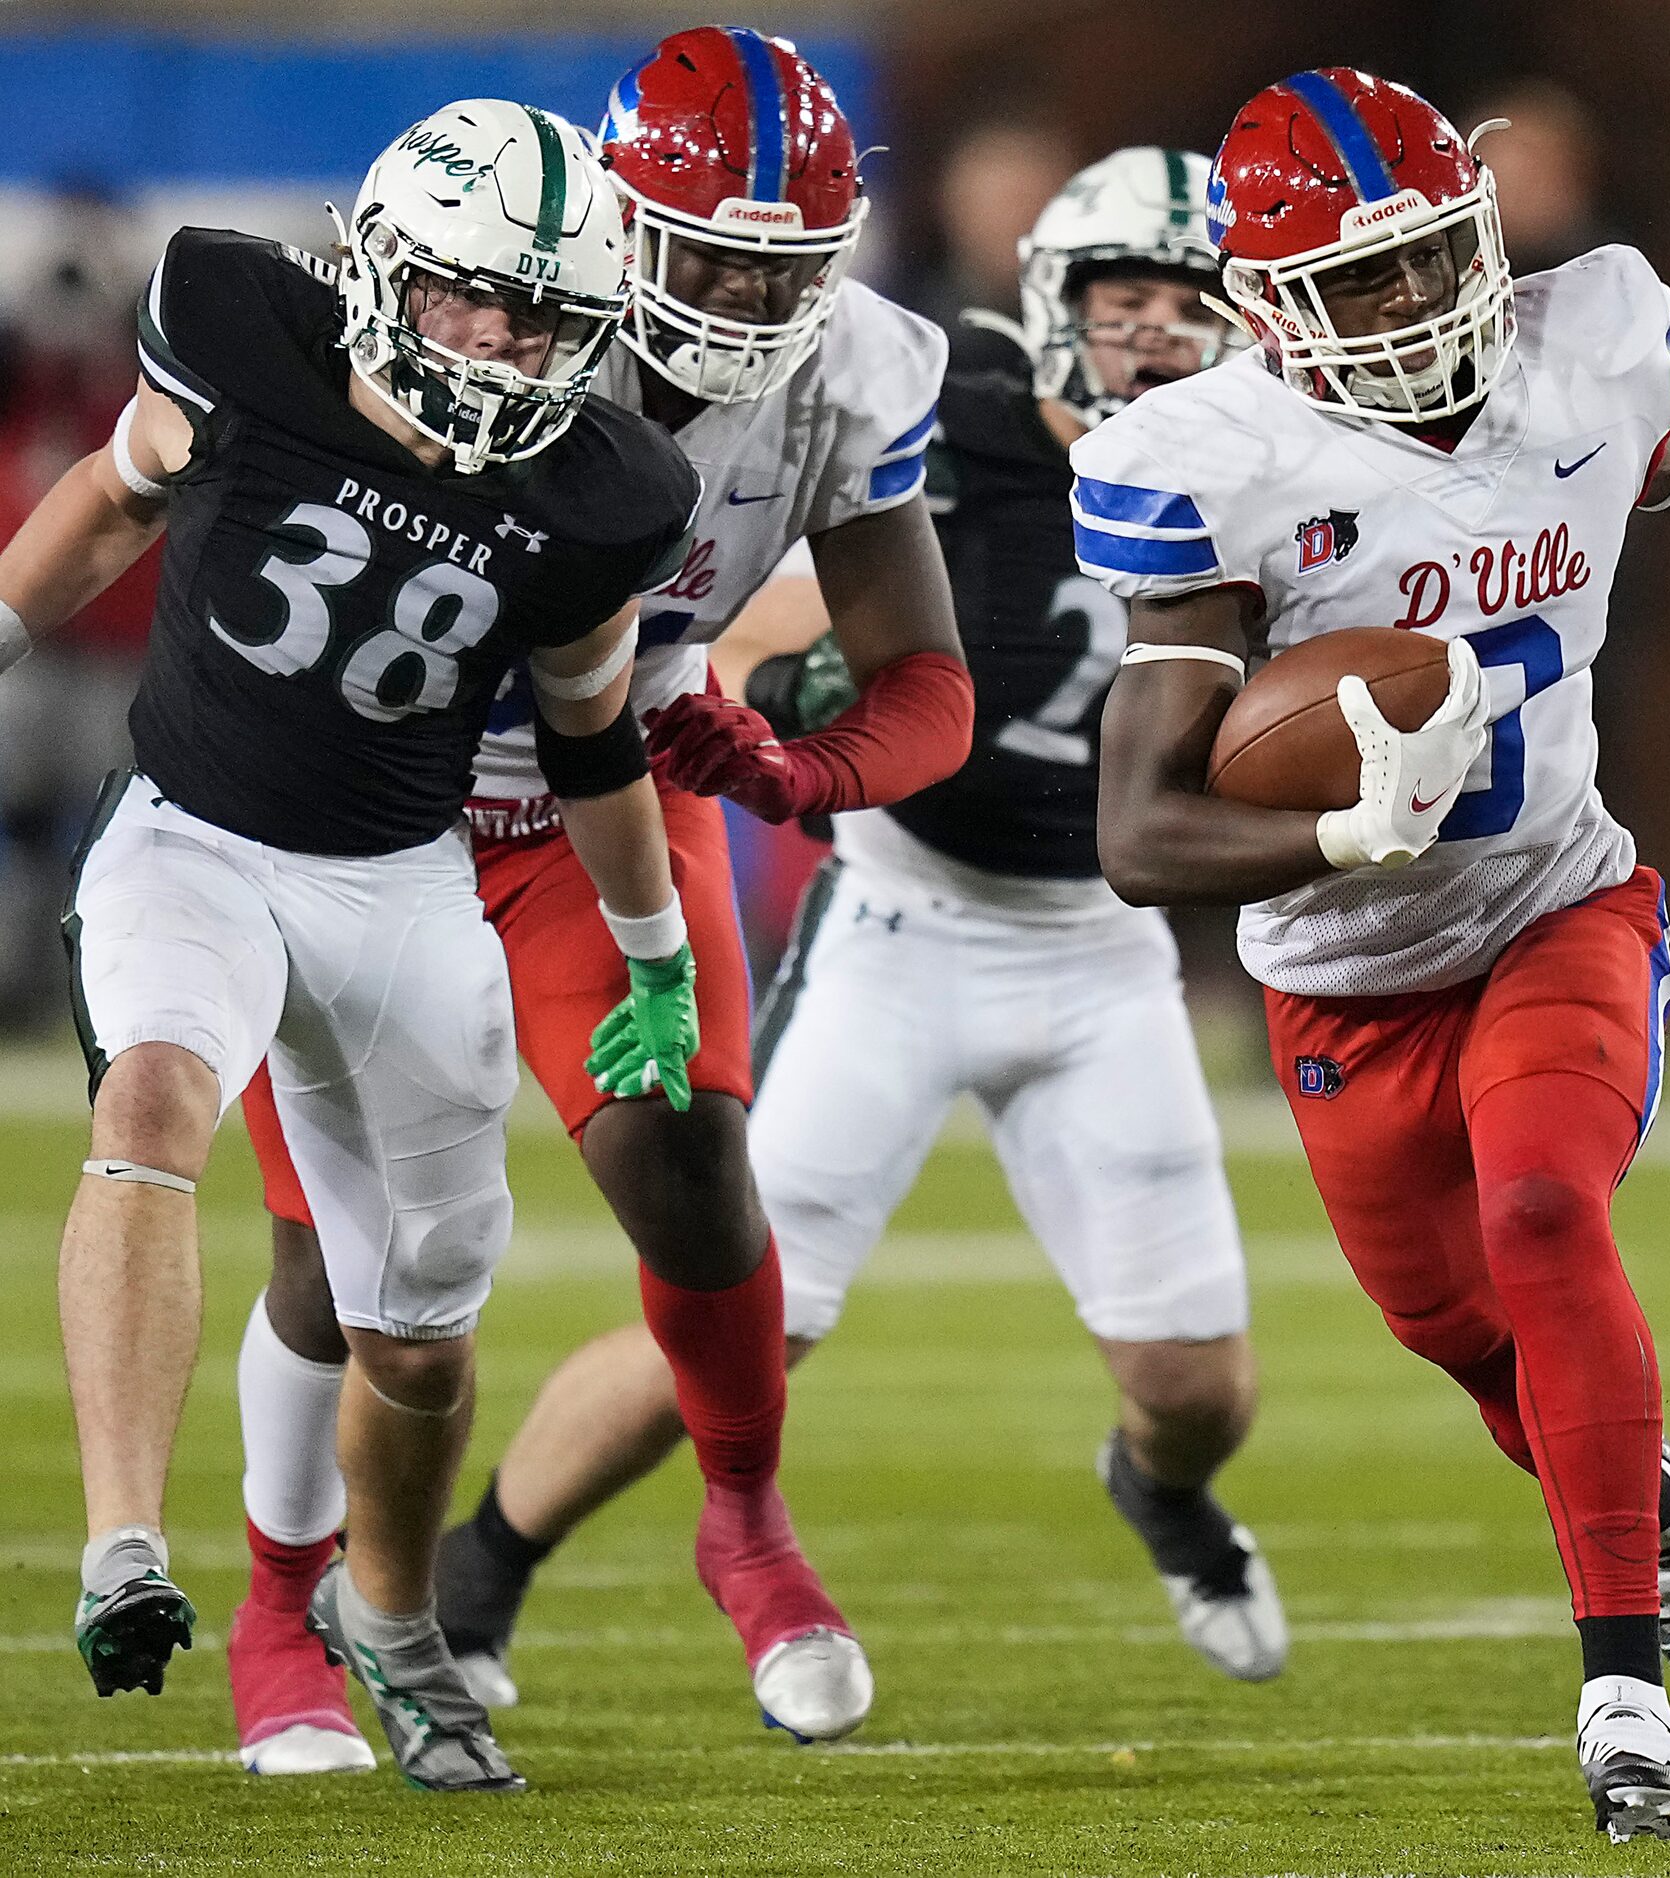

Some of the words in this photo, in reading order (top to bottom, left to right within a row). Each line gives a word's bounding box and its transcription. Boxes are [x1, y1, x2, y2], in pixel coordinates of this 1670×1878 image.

[515, 252, 561, 283] DYJ
[335, 477, 493, 576] PROSPER
[1393, 521, 1591, 631] D'Ville
[209, 502, 500, 724] 38
